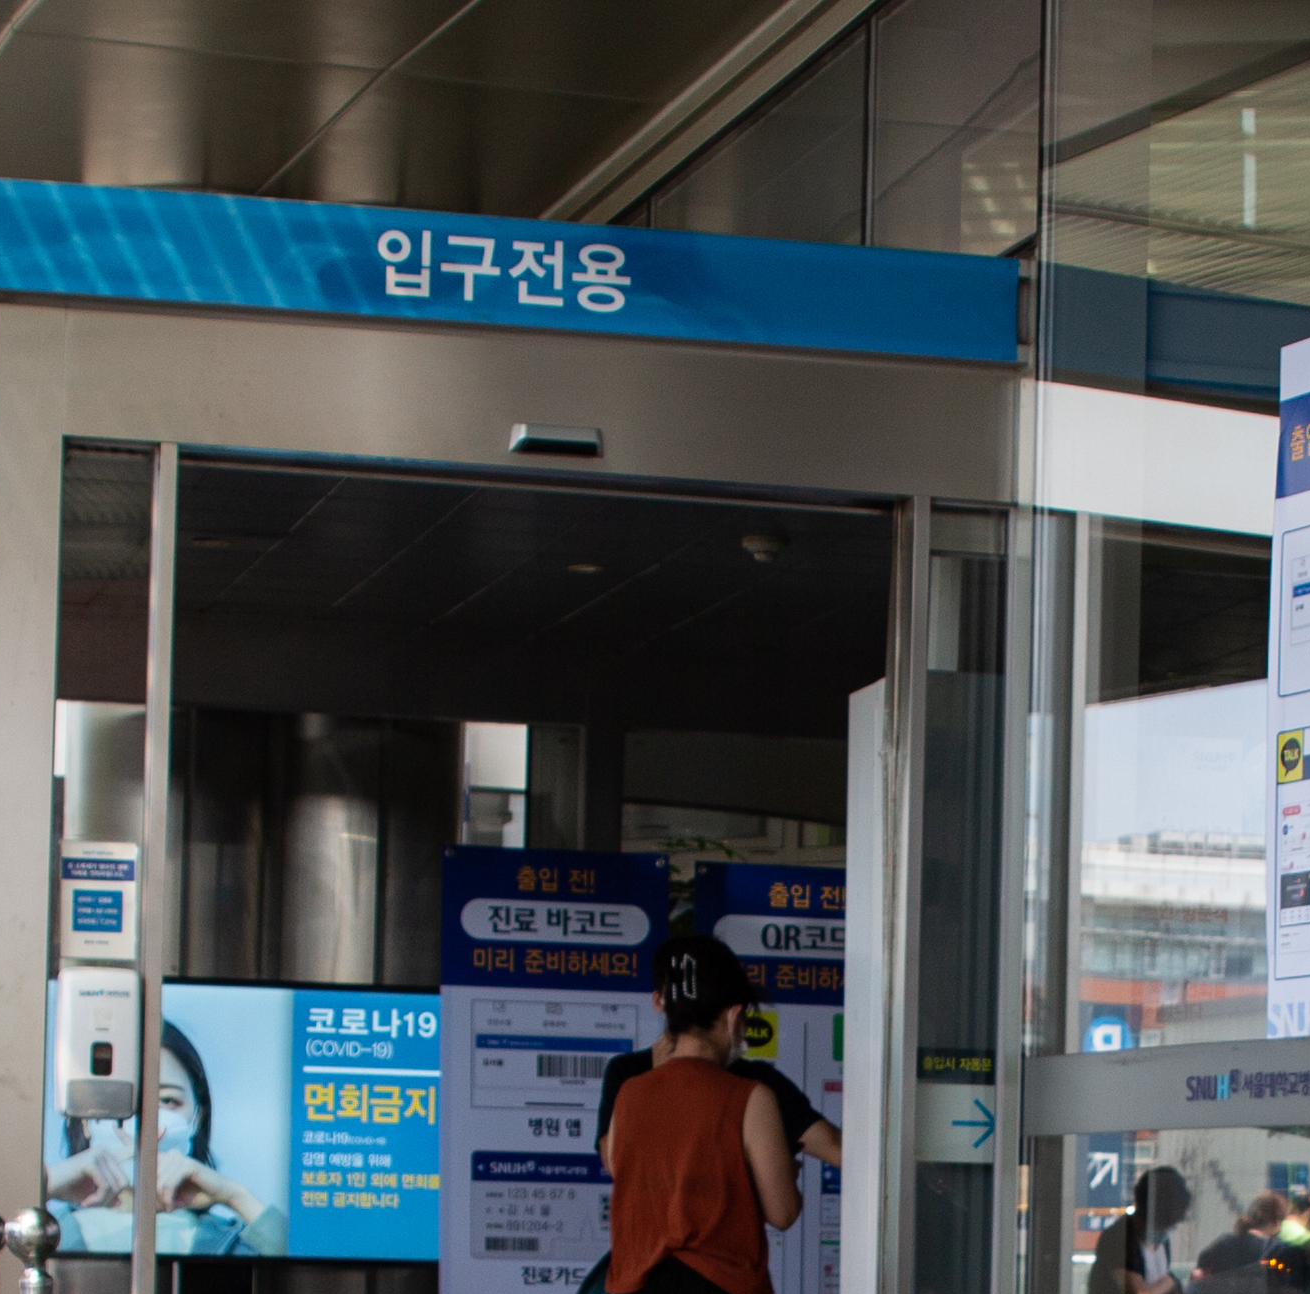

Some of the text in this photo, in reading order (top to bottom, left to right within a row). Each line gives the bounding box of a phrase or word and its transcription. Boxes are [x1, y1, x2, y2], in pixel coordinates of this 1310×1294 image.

[377, 229, 632, 313] 입구전용
[515, 866, 596, 895] 출입 전!
[769, 882, 811, 909] 출입
[487, 905, 624, 938] 진료 바코드
[473, 947, 638, 979] 미리 준비하세요!
[741, 962, 846, 992] 리 준비하
[305, 1007, 437, 1039] 코로나19
[744, 1027, 769, 1038] ALK
[305, 1039, 393, 1060] (COVID-19)
[1186, 1074, 1230, 1101] SNUH
[304, 1082, 437, 1126] 면회금지
[528, 1117, 561, 1137] 병원
[368, 1153, 392, 1169] 위해
[301, 1170, 343, 1188] 보호자
[332, 1191, 400, 1209] 금지합니다
